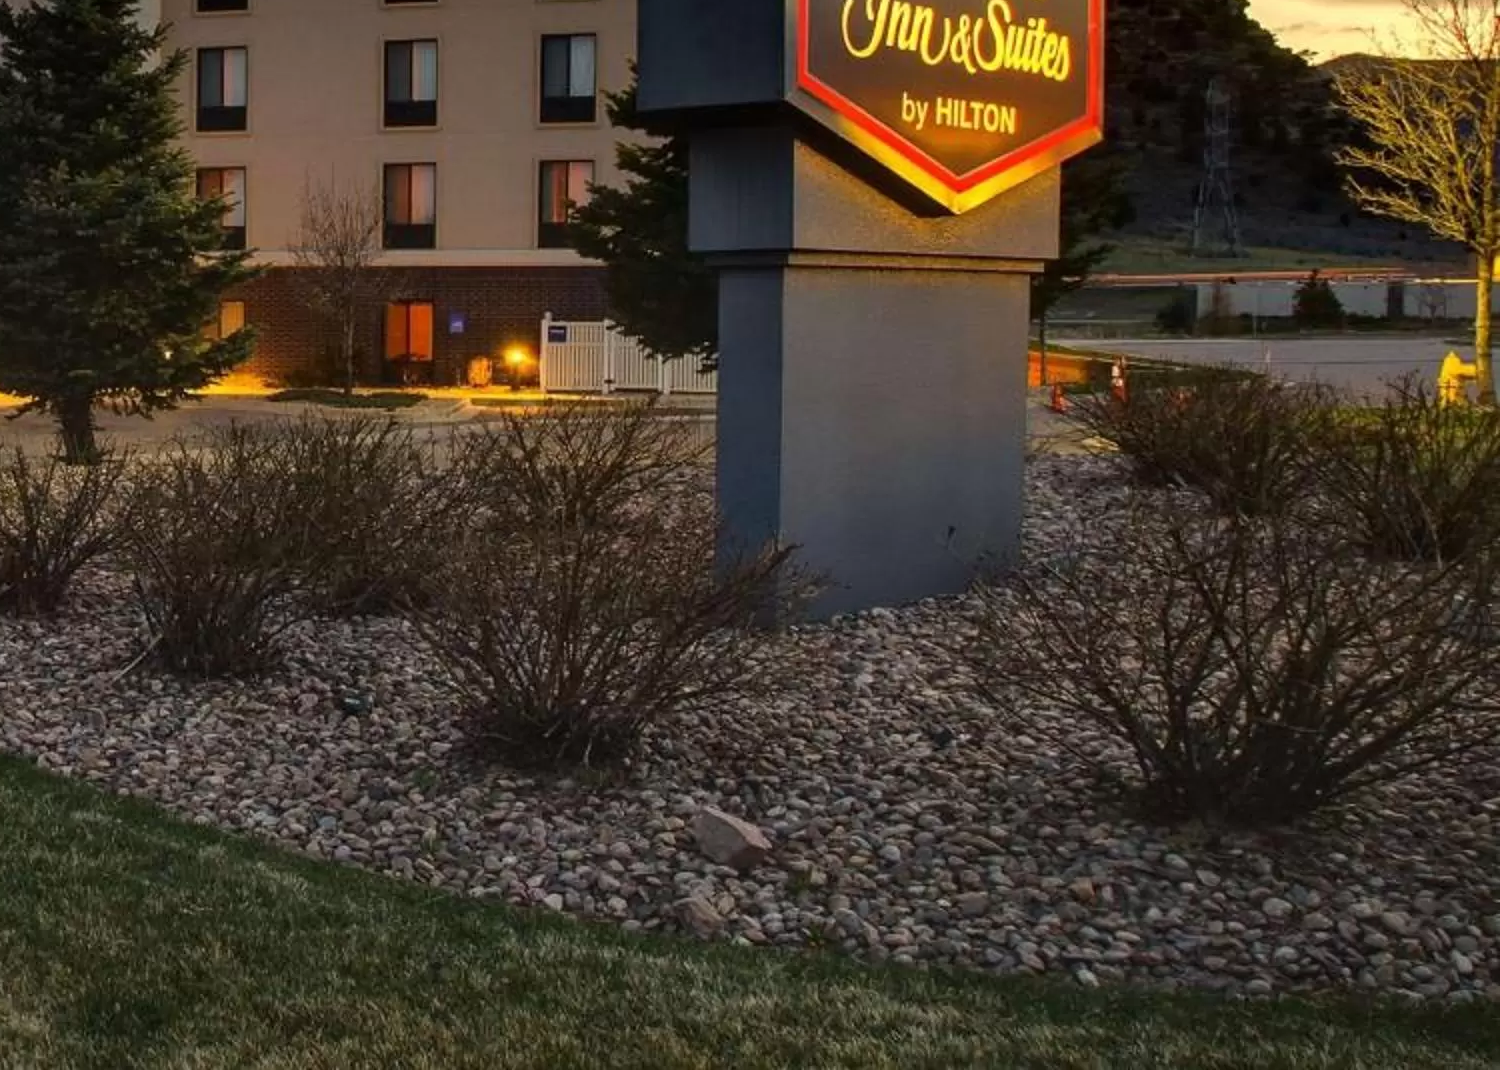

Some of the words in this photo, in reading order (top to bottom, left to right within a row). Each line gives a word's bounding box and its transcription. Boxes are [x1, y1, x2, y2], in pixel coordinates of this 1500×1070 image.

[950, 14, 976, 74] &
[902, 92, 928, 130] by
[936, 96, 1017, 134] HILTON
